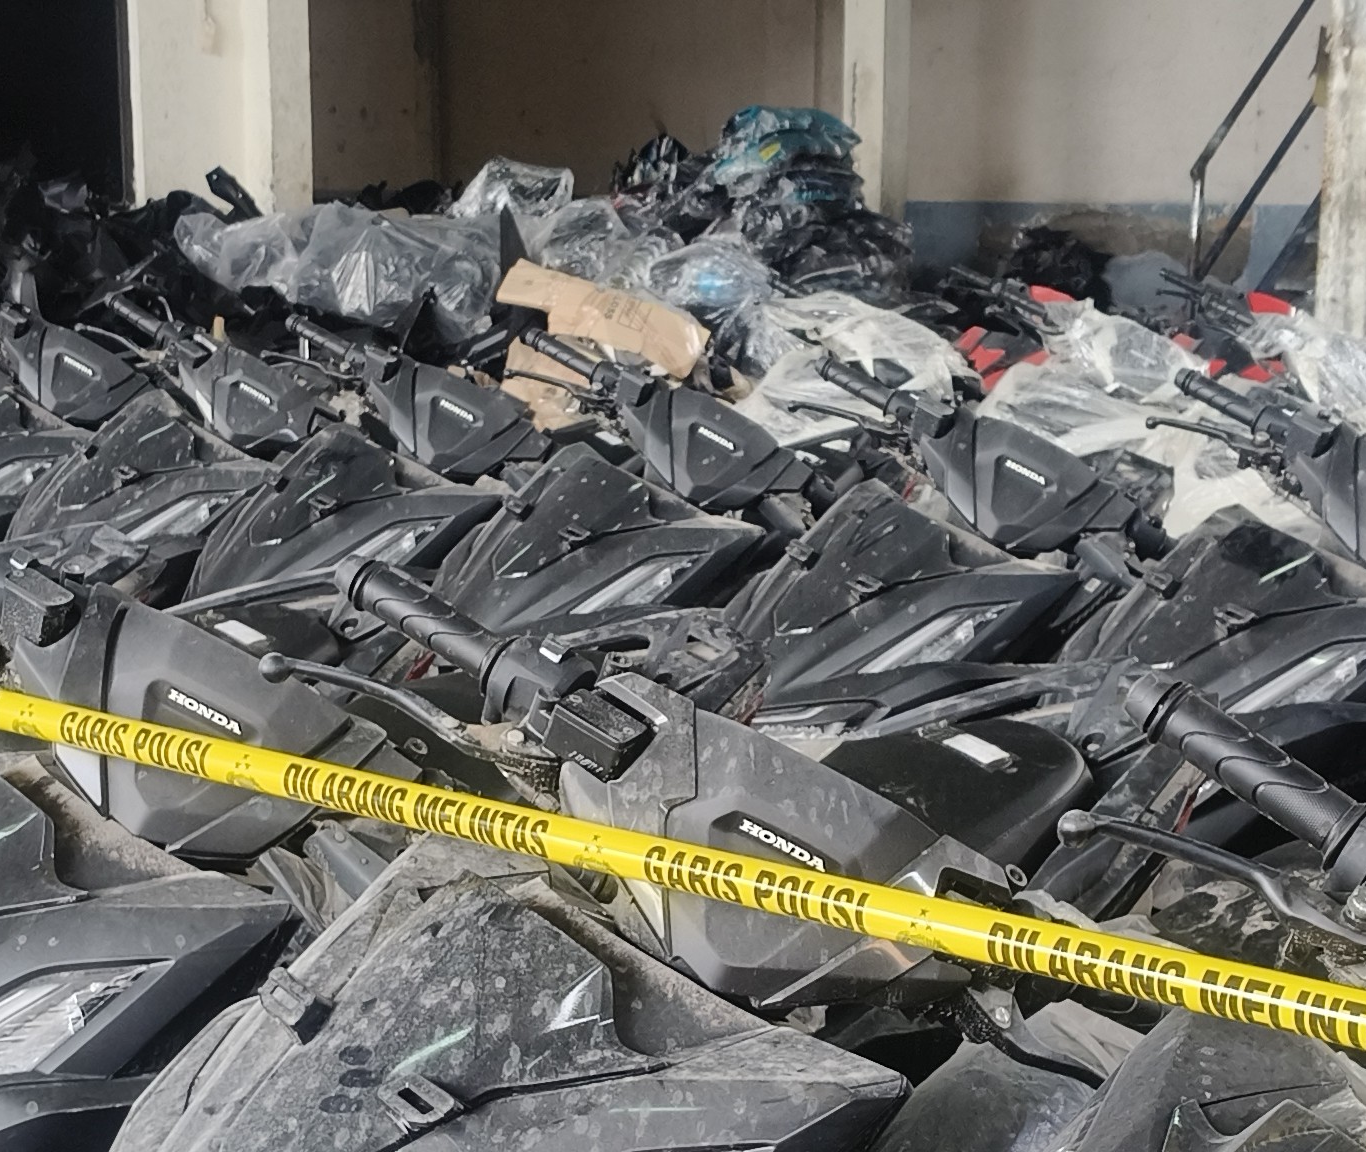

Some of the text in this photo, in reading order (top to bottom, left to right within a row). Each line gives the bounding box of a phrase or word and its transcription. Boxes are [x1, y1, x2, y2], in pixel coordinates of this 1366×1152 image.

[59, 711, 214, 778] GARIS POLISI
[167, 688, 242, 736] HONDA
[283, 762, 550, 859] DILARANG MELINTAS
[738, 818, 827, 873] HONDA
[643, 845, 871, 935] GARIS POLISI
[986, 921, 1187, 1008] DILARANG
